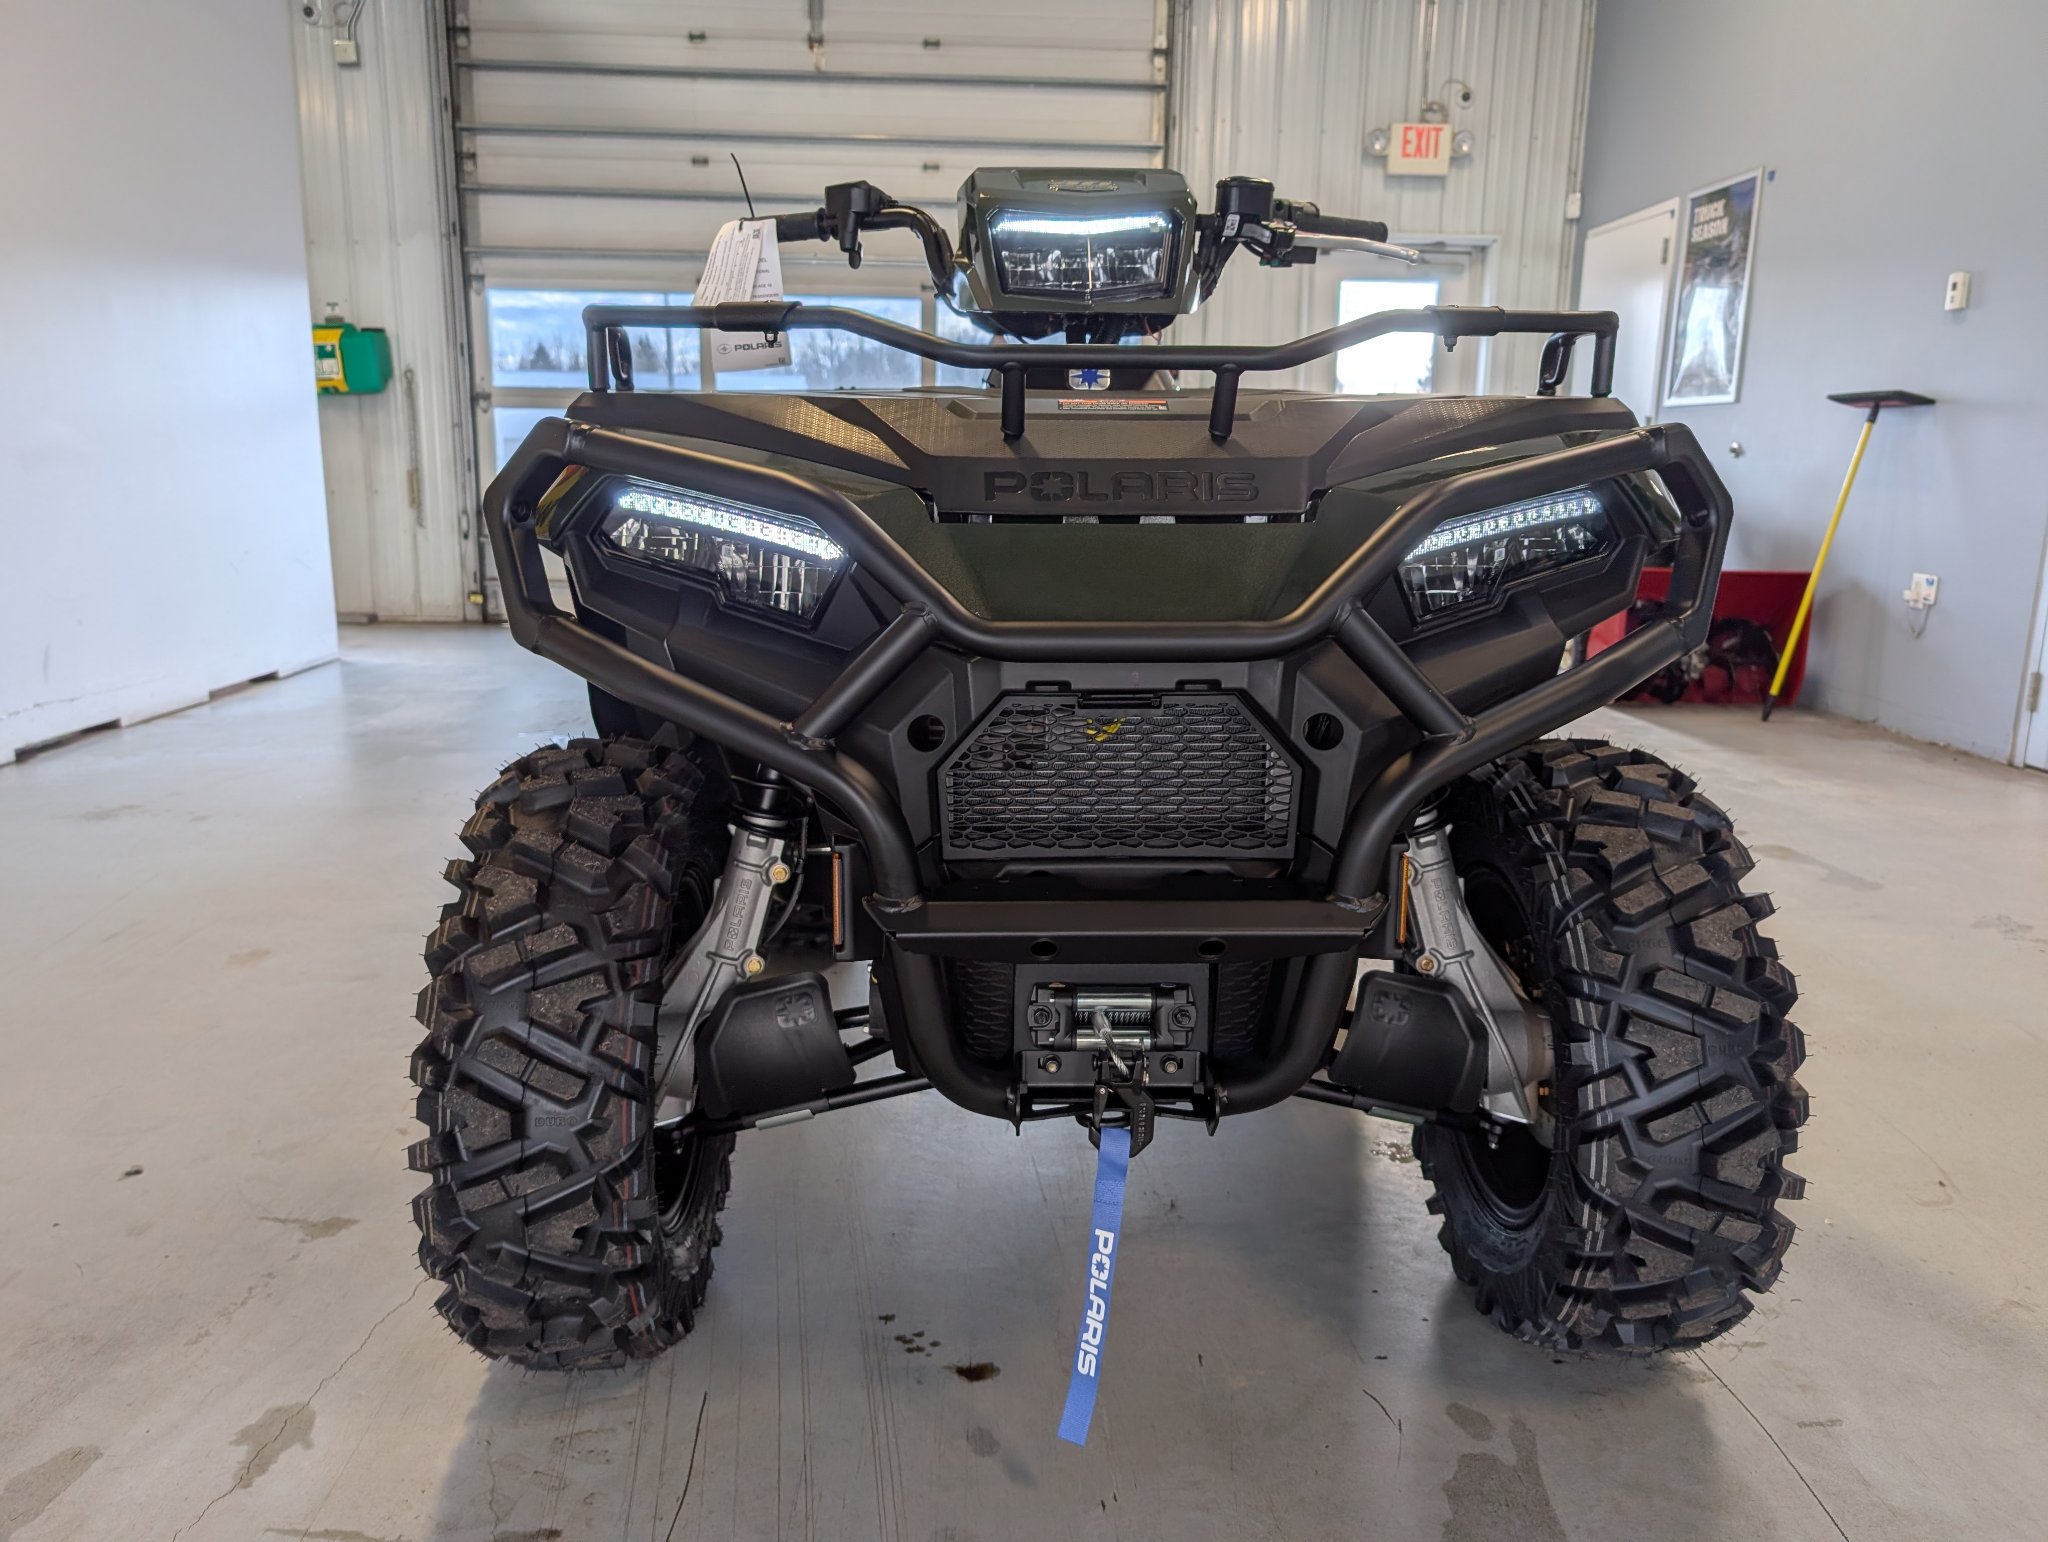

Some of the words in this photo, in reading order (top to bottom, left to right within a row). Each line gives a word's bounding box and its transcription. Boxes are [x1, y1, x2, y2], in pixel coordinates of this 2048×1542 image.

[1401, 126, 1443, 159] EXIT
[1694, 199, 1727, 223] TRUCK
[1691, 216, 1730, 242] SEASON
[734, 341, 783, 351] POLARS
[983, 470, 1260, 502] POLARIS
[723, 878, 753, 952] POLARIS
[1431, 878, 1458, 952] POLARIS
[534, 1115, 578, 1128] DURO
[1077, 1228, 1115, 1378] POLARIS
